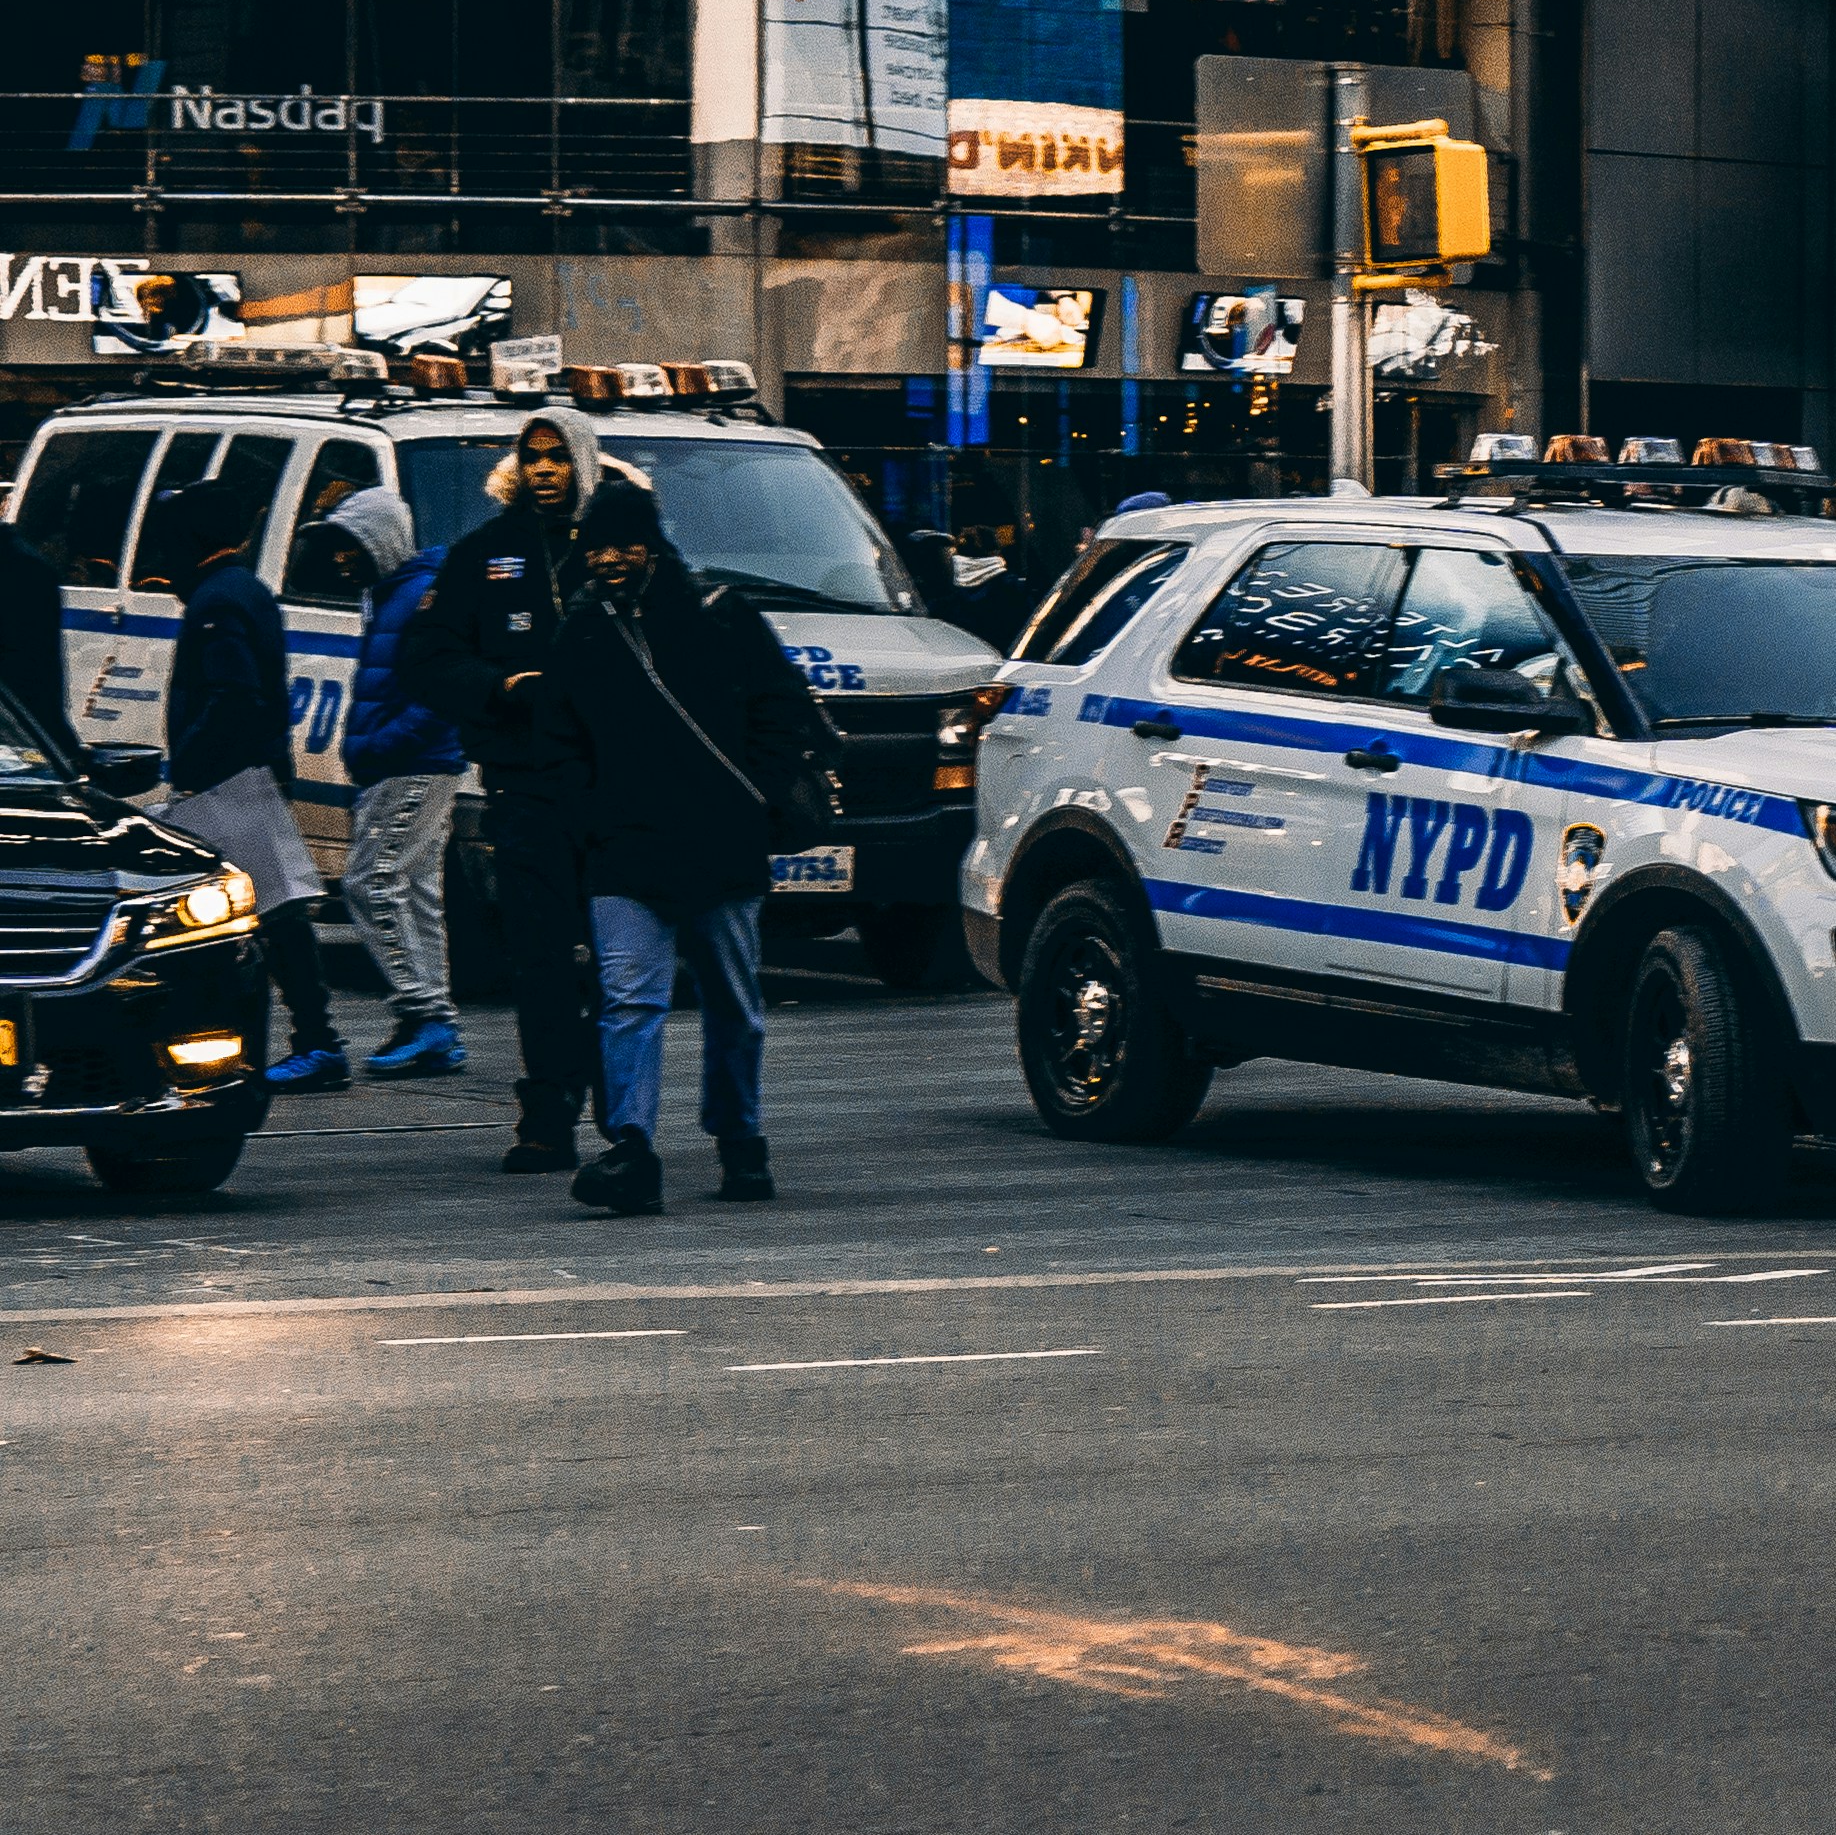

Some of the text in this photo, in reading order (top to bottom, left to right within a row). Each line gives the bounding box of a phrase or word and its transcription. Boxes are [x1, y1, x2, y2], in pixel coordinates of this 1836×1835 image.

[170, 83, 384, 144] Nasdaq
[287, 675, 344, 755] PD
[1668, 778, 1765, 824] POLICE
[1350, 791, 1535, 912] NYPD
